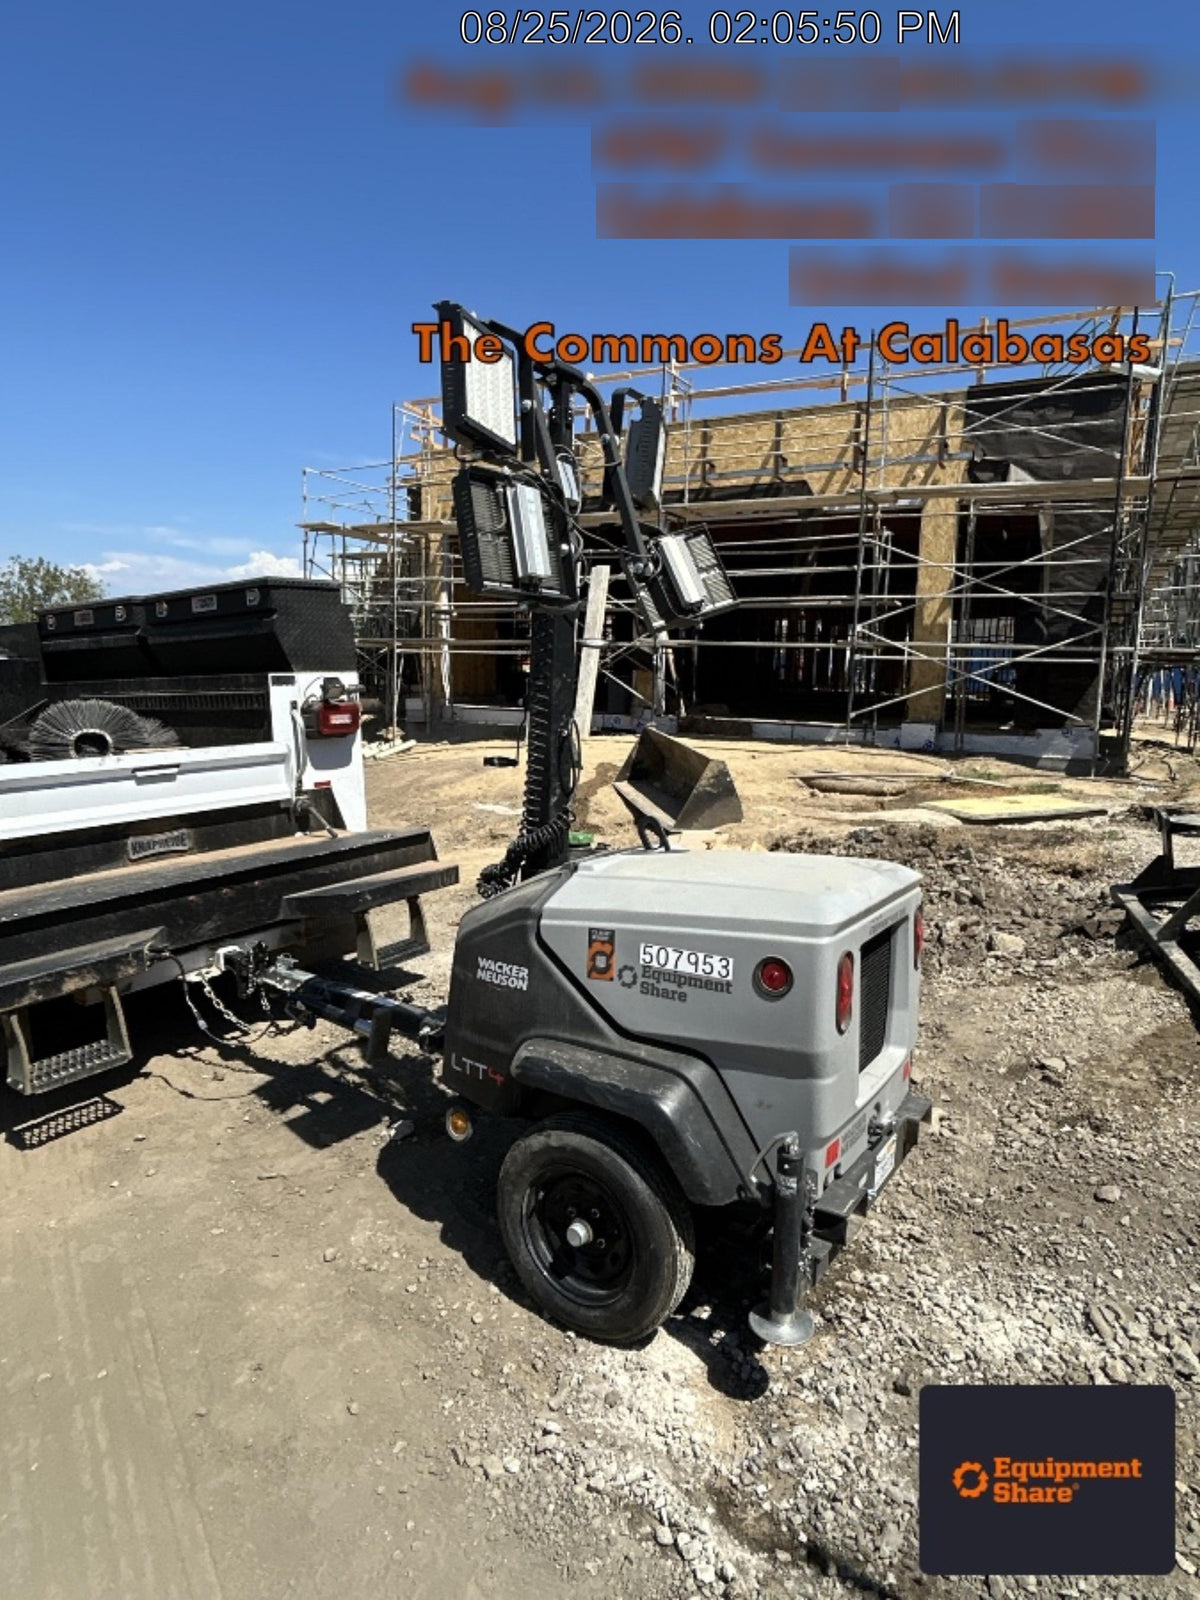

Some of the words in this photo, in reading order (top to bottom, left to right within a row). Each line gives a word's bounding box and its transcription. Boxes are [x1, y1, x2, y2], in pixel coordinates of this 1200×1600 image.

[478, 956, 529, 980] WACKER
[641, 945, 731, 979] 507953
[476, 968, 528, 991] NEUSON
[640, 980, 688, 1003] Share
[641, 966, 733, 994] Equipment
[451, 1053, 504, 1086] LTT4
